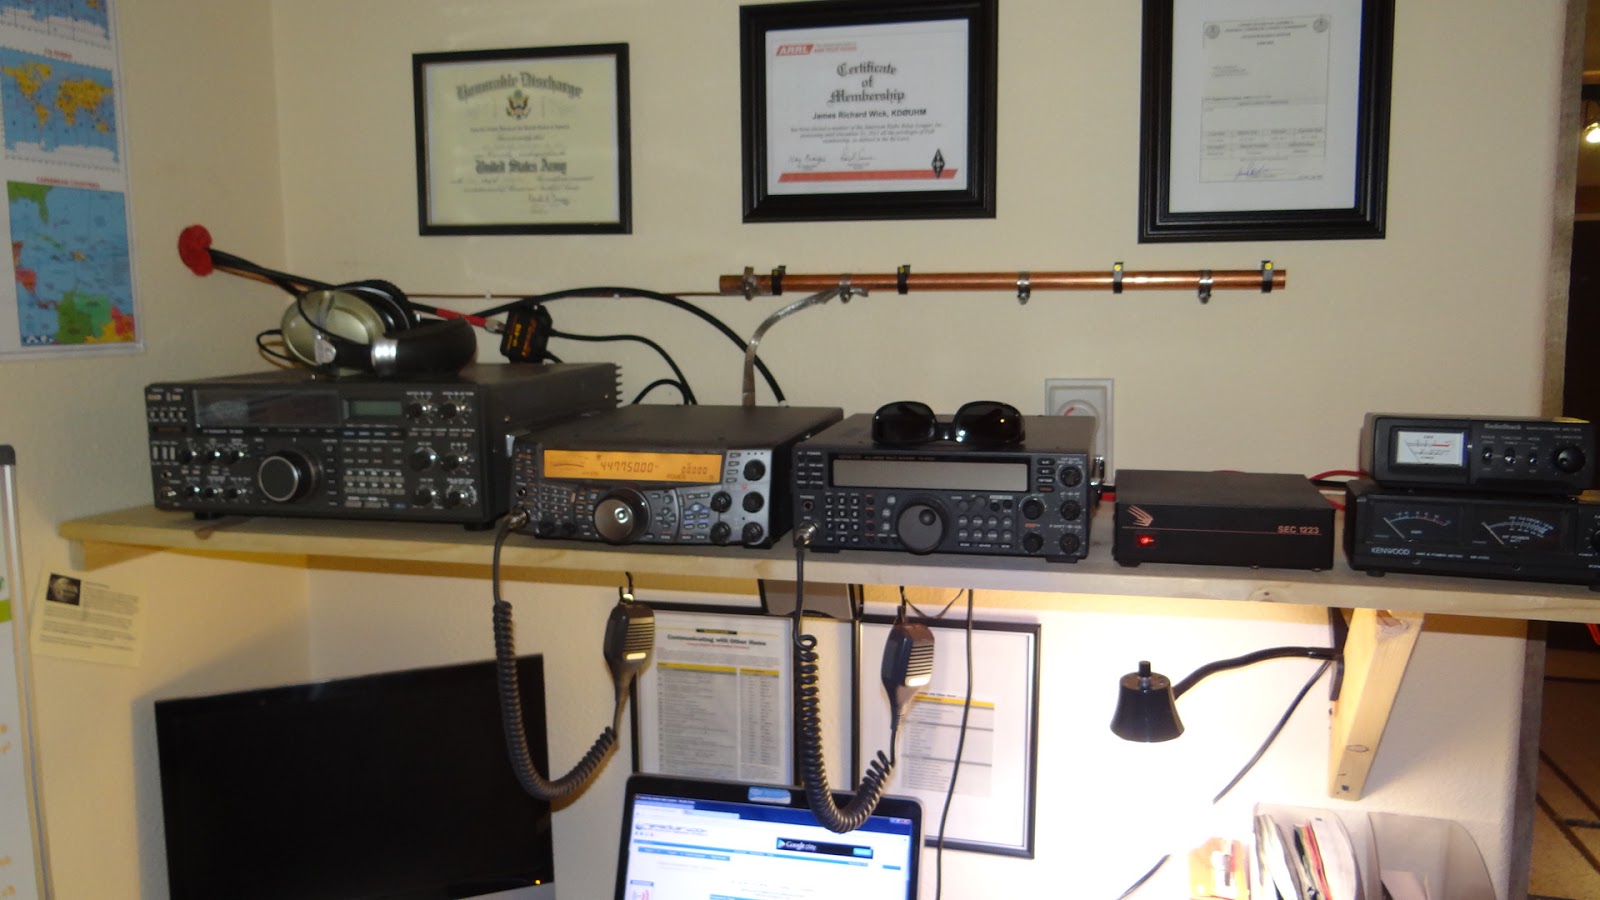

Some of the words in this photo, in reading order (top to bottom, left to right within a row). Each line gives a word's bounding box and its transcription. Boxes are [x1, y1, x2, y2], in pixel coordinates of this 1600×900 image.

[836, 61, 897, 77] Certificate
[861, 75, 873, 88] of
[827, 89, 906, 104] Membership
[812, 112, 836, 120] James
[838, 111, 867, 119] Richard
[869, 110, 889, 119] Wick,
[1277, 525, 1296, 534] SEC
[1299, 526, 1320, 534] 1223
[1371, 547, 1410, 556] KENWOOD
